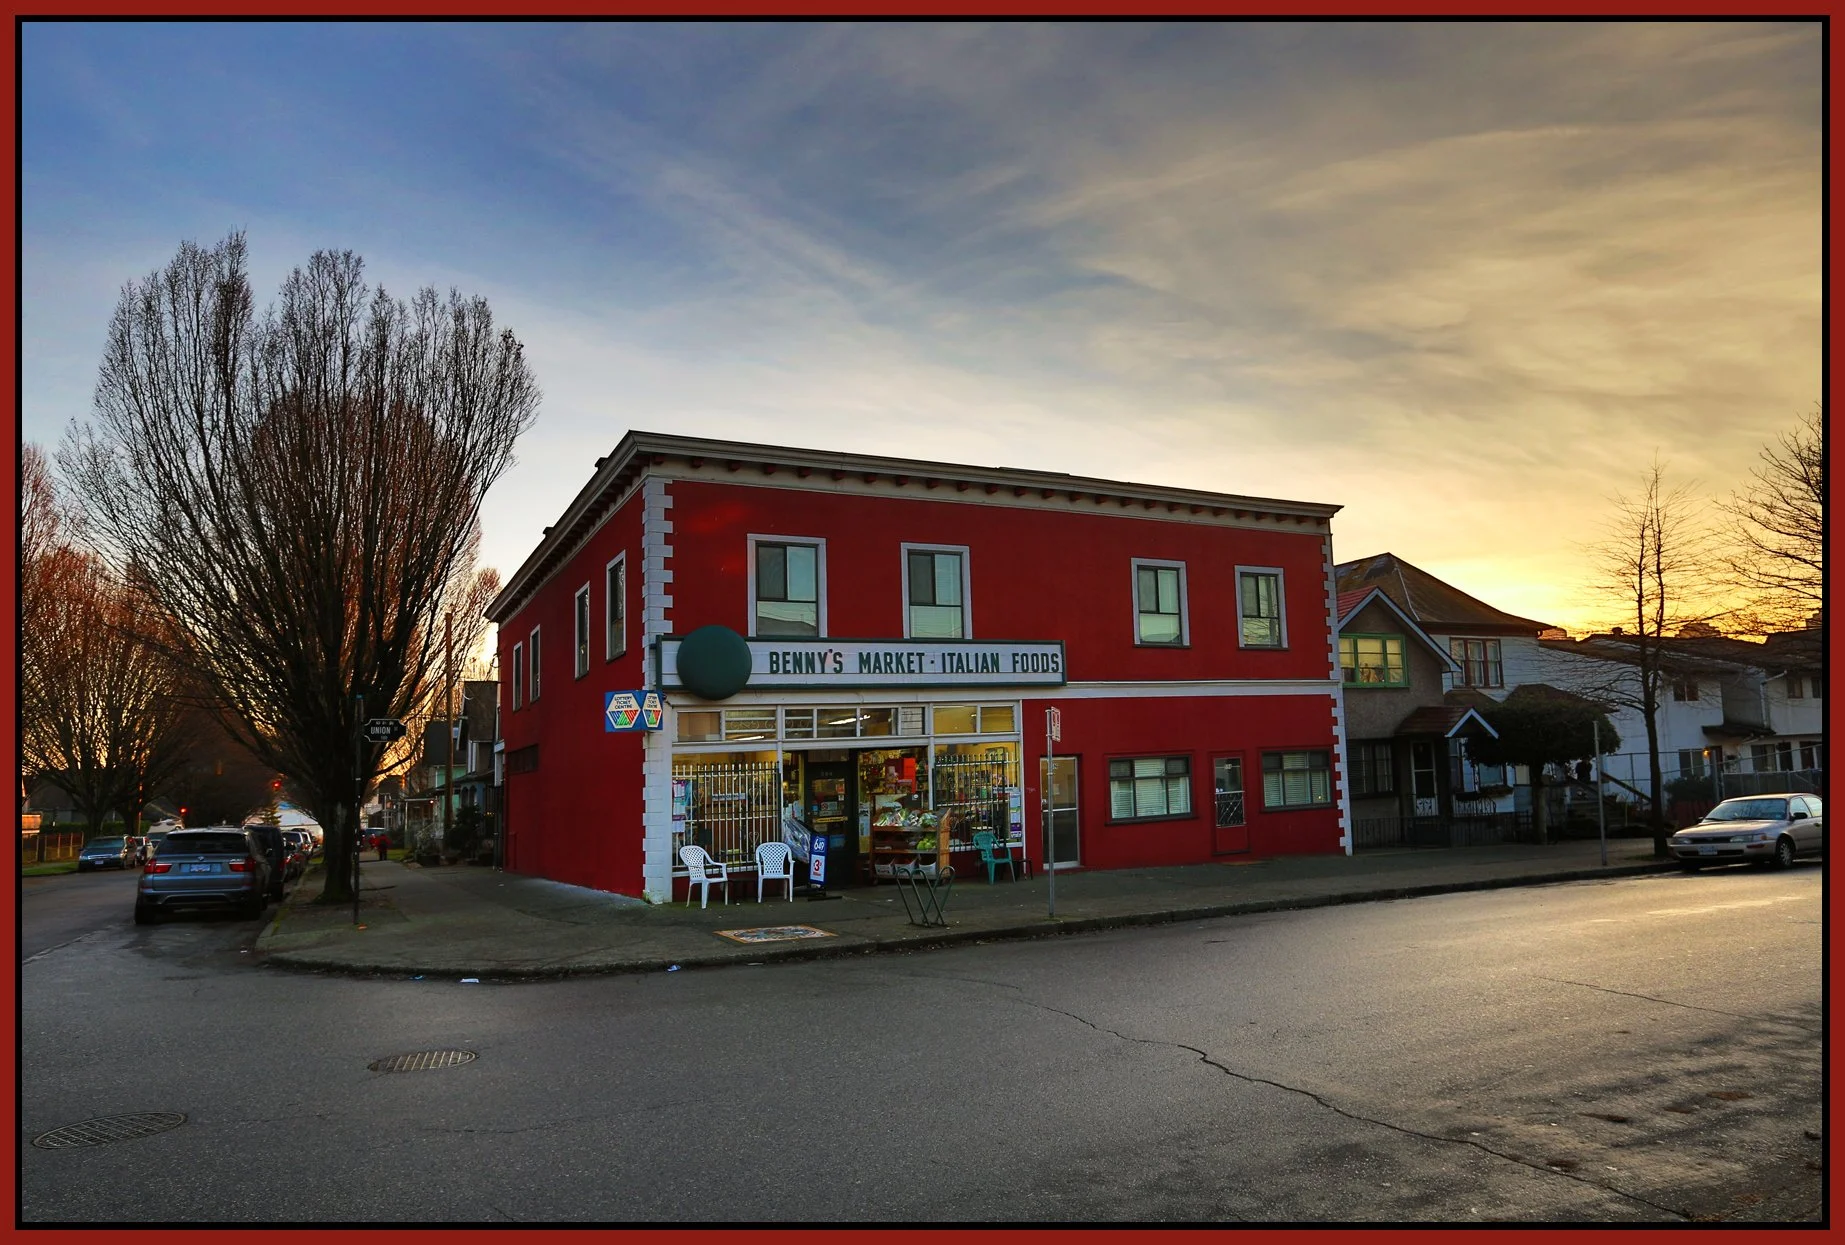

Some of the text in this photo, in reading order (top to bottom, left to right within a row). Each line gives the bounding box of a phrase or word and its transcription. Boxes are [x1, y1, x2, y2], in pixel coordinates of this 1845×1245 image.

[769, 648, 1060, 674] BENNY'S MARKET ITALIAN FOODS
[370, 726, 391, 735] UNION
[813, 838, 825, 851] 649
